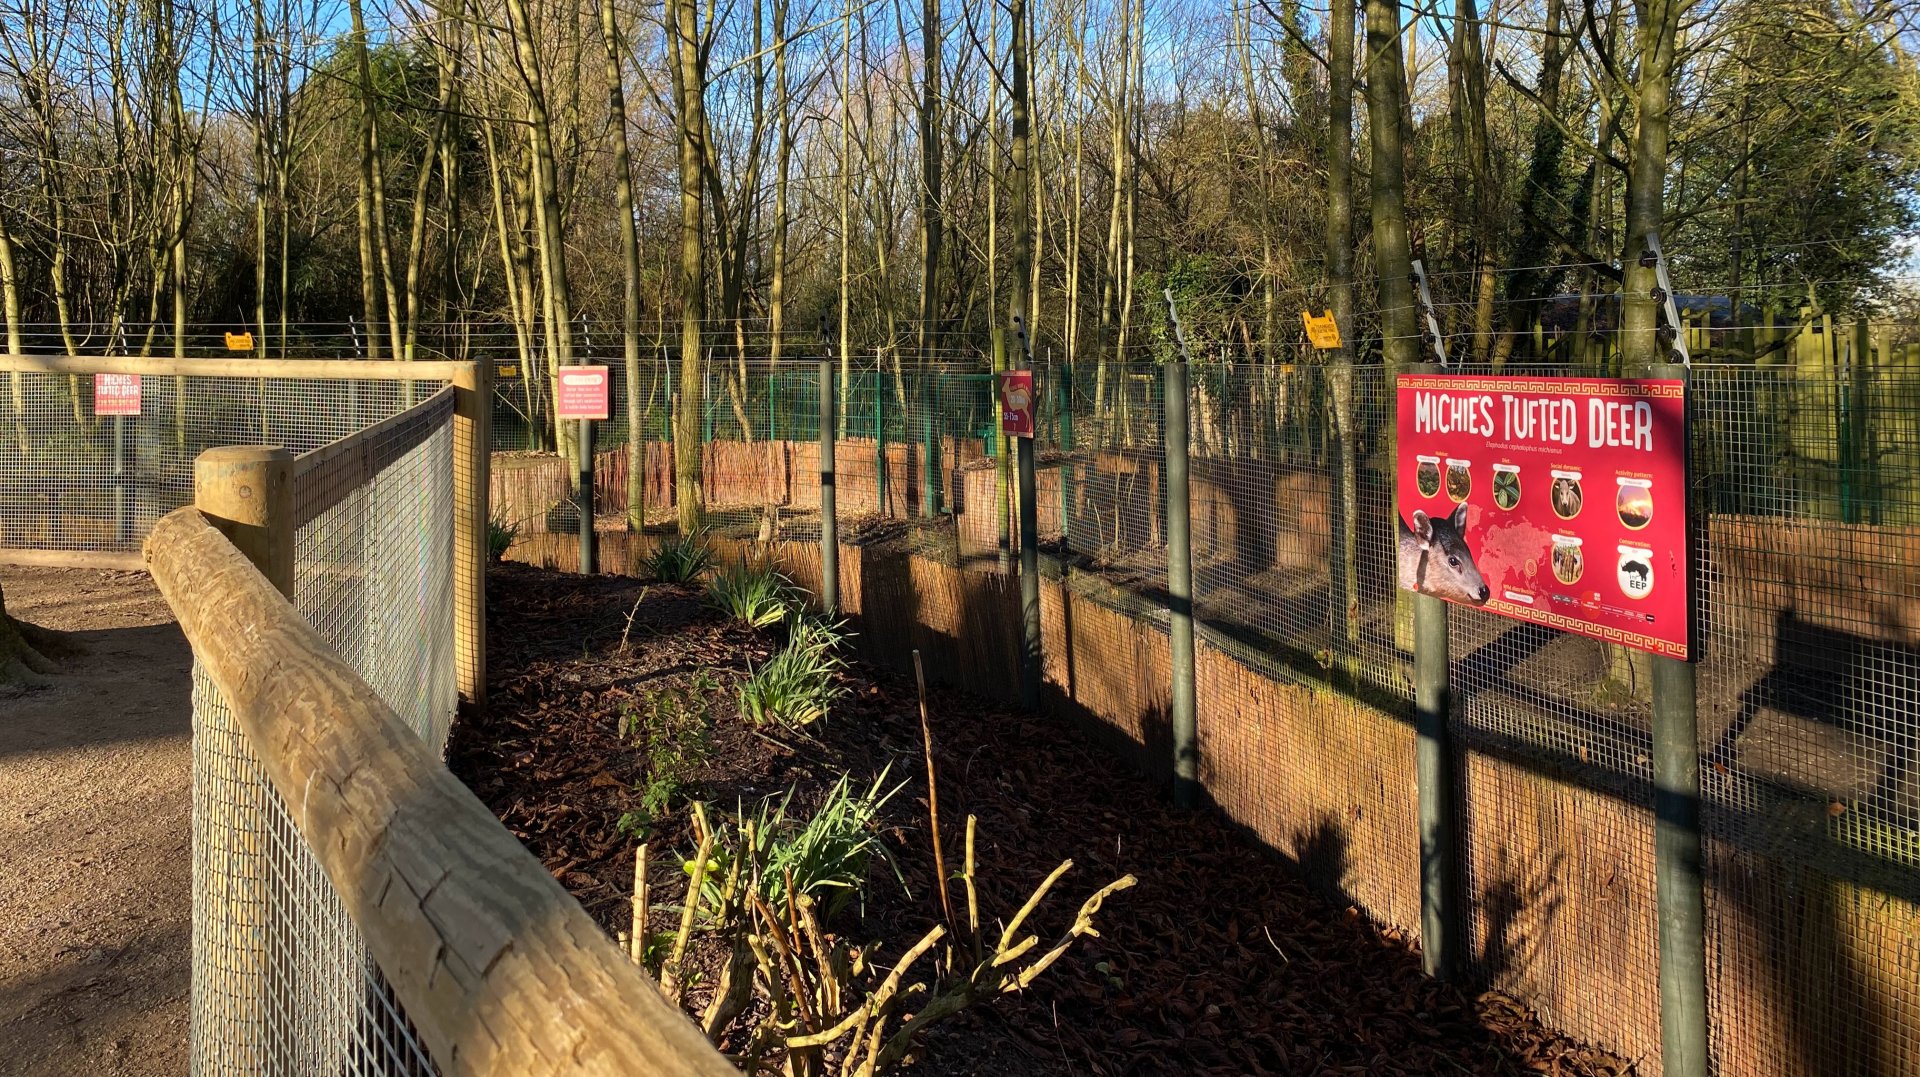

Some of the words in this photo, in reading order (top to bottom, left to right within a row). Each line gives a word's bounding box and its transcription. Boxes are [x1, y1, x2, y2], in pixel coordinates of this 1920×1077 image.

[1415, 391, 1494, 437] MICHIE'S
[1502, 395, 1577, 445] TUFTED
[1589, 398, 1653, 451] DEER
[1630, 580, 1647, 590] EEP
